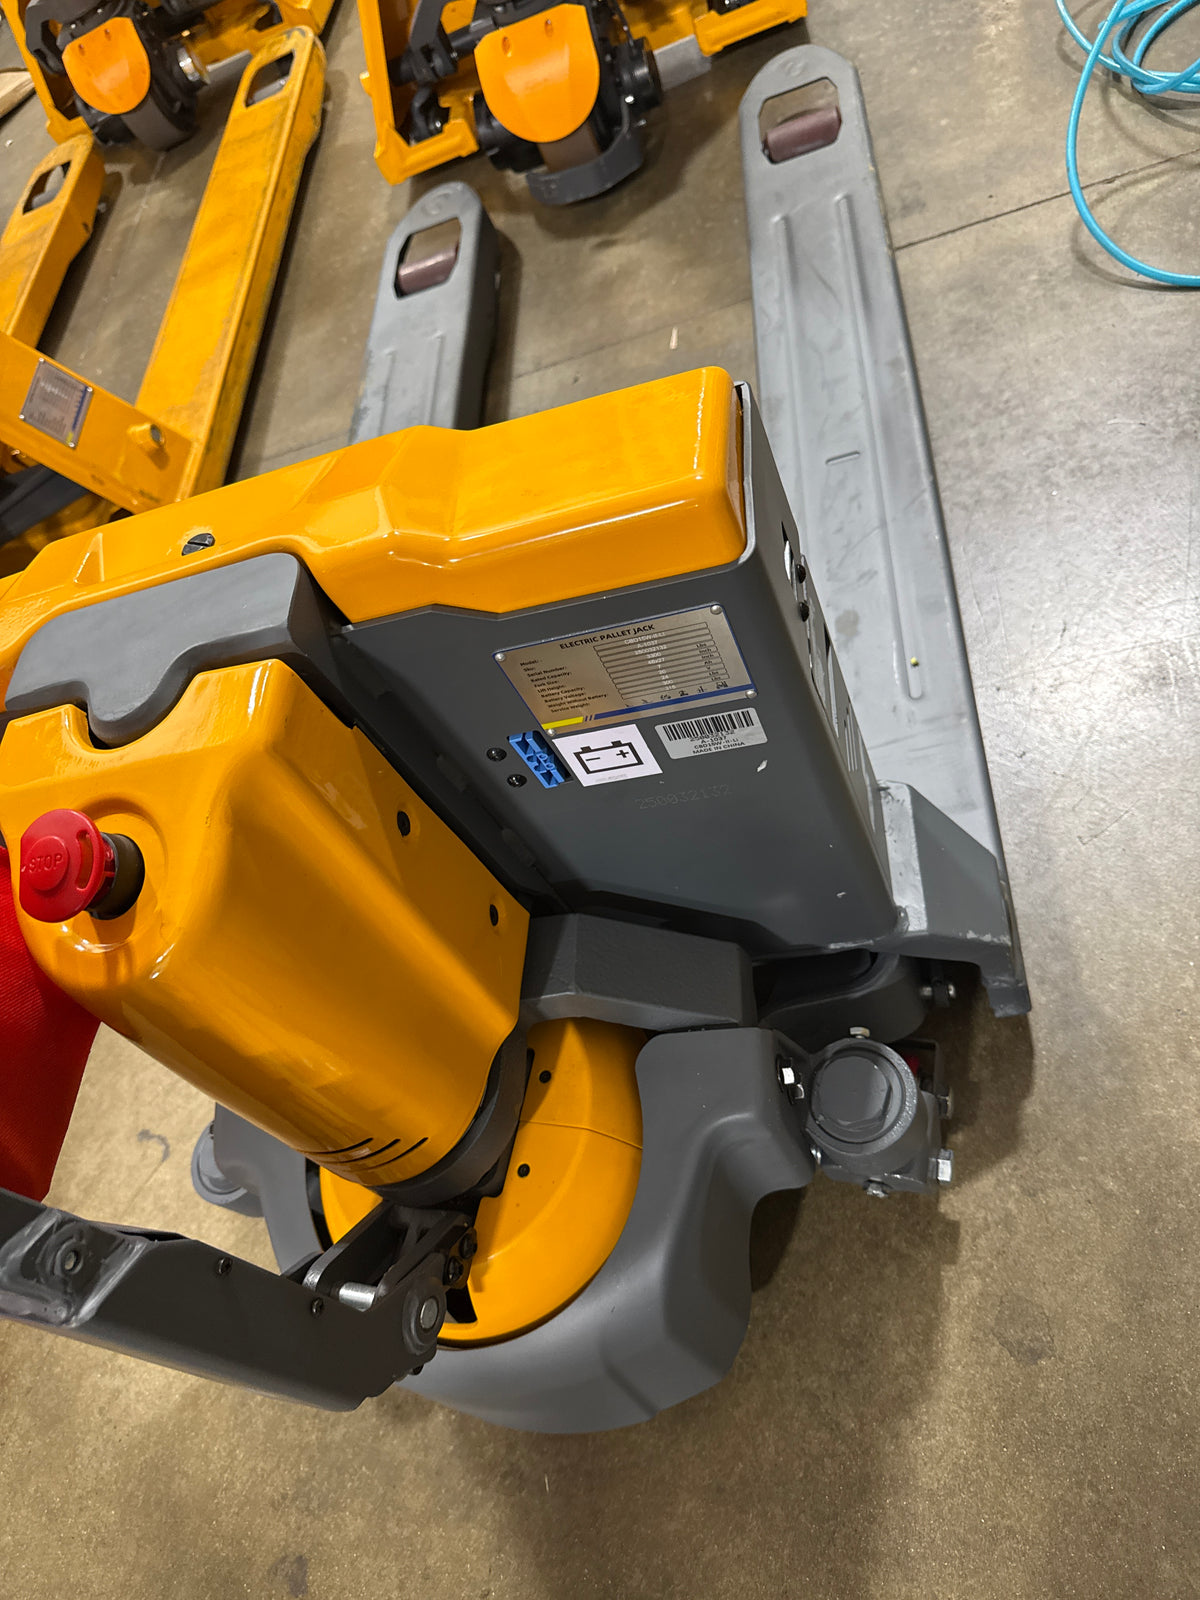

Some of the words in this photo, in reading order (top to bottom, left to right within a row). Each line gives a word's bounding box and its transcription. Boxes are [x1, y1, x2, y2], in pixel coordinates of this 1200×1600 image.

[560, 637, 598, 649] ELECTRIC
[600, 628, 630, 640] PALLET
[632, 624, 655, 635] JACK
[29, 854, 62, 873] STOP
